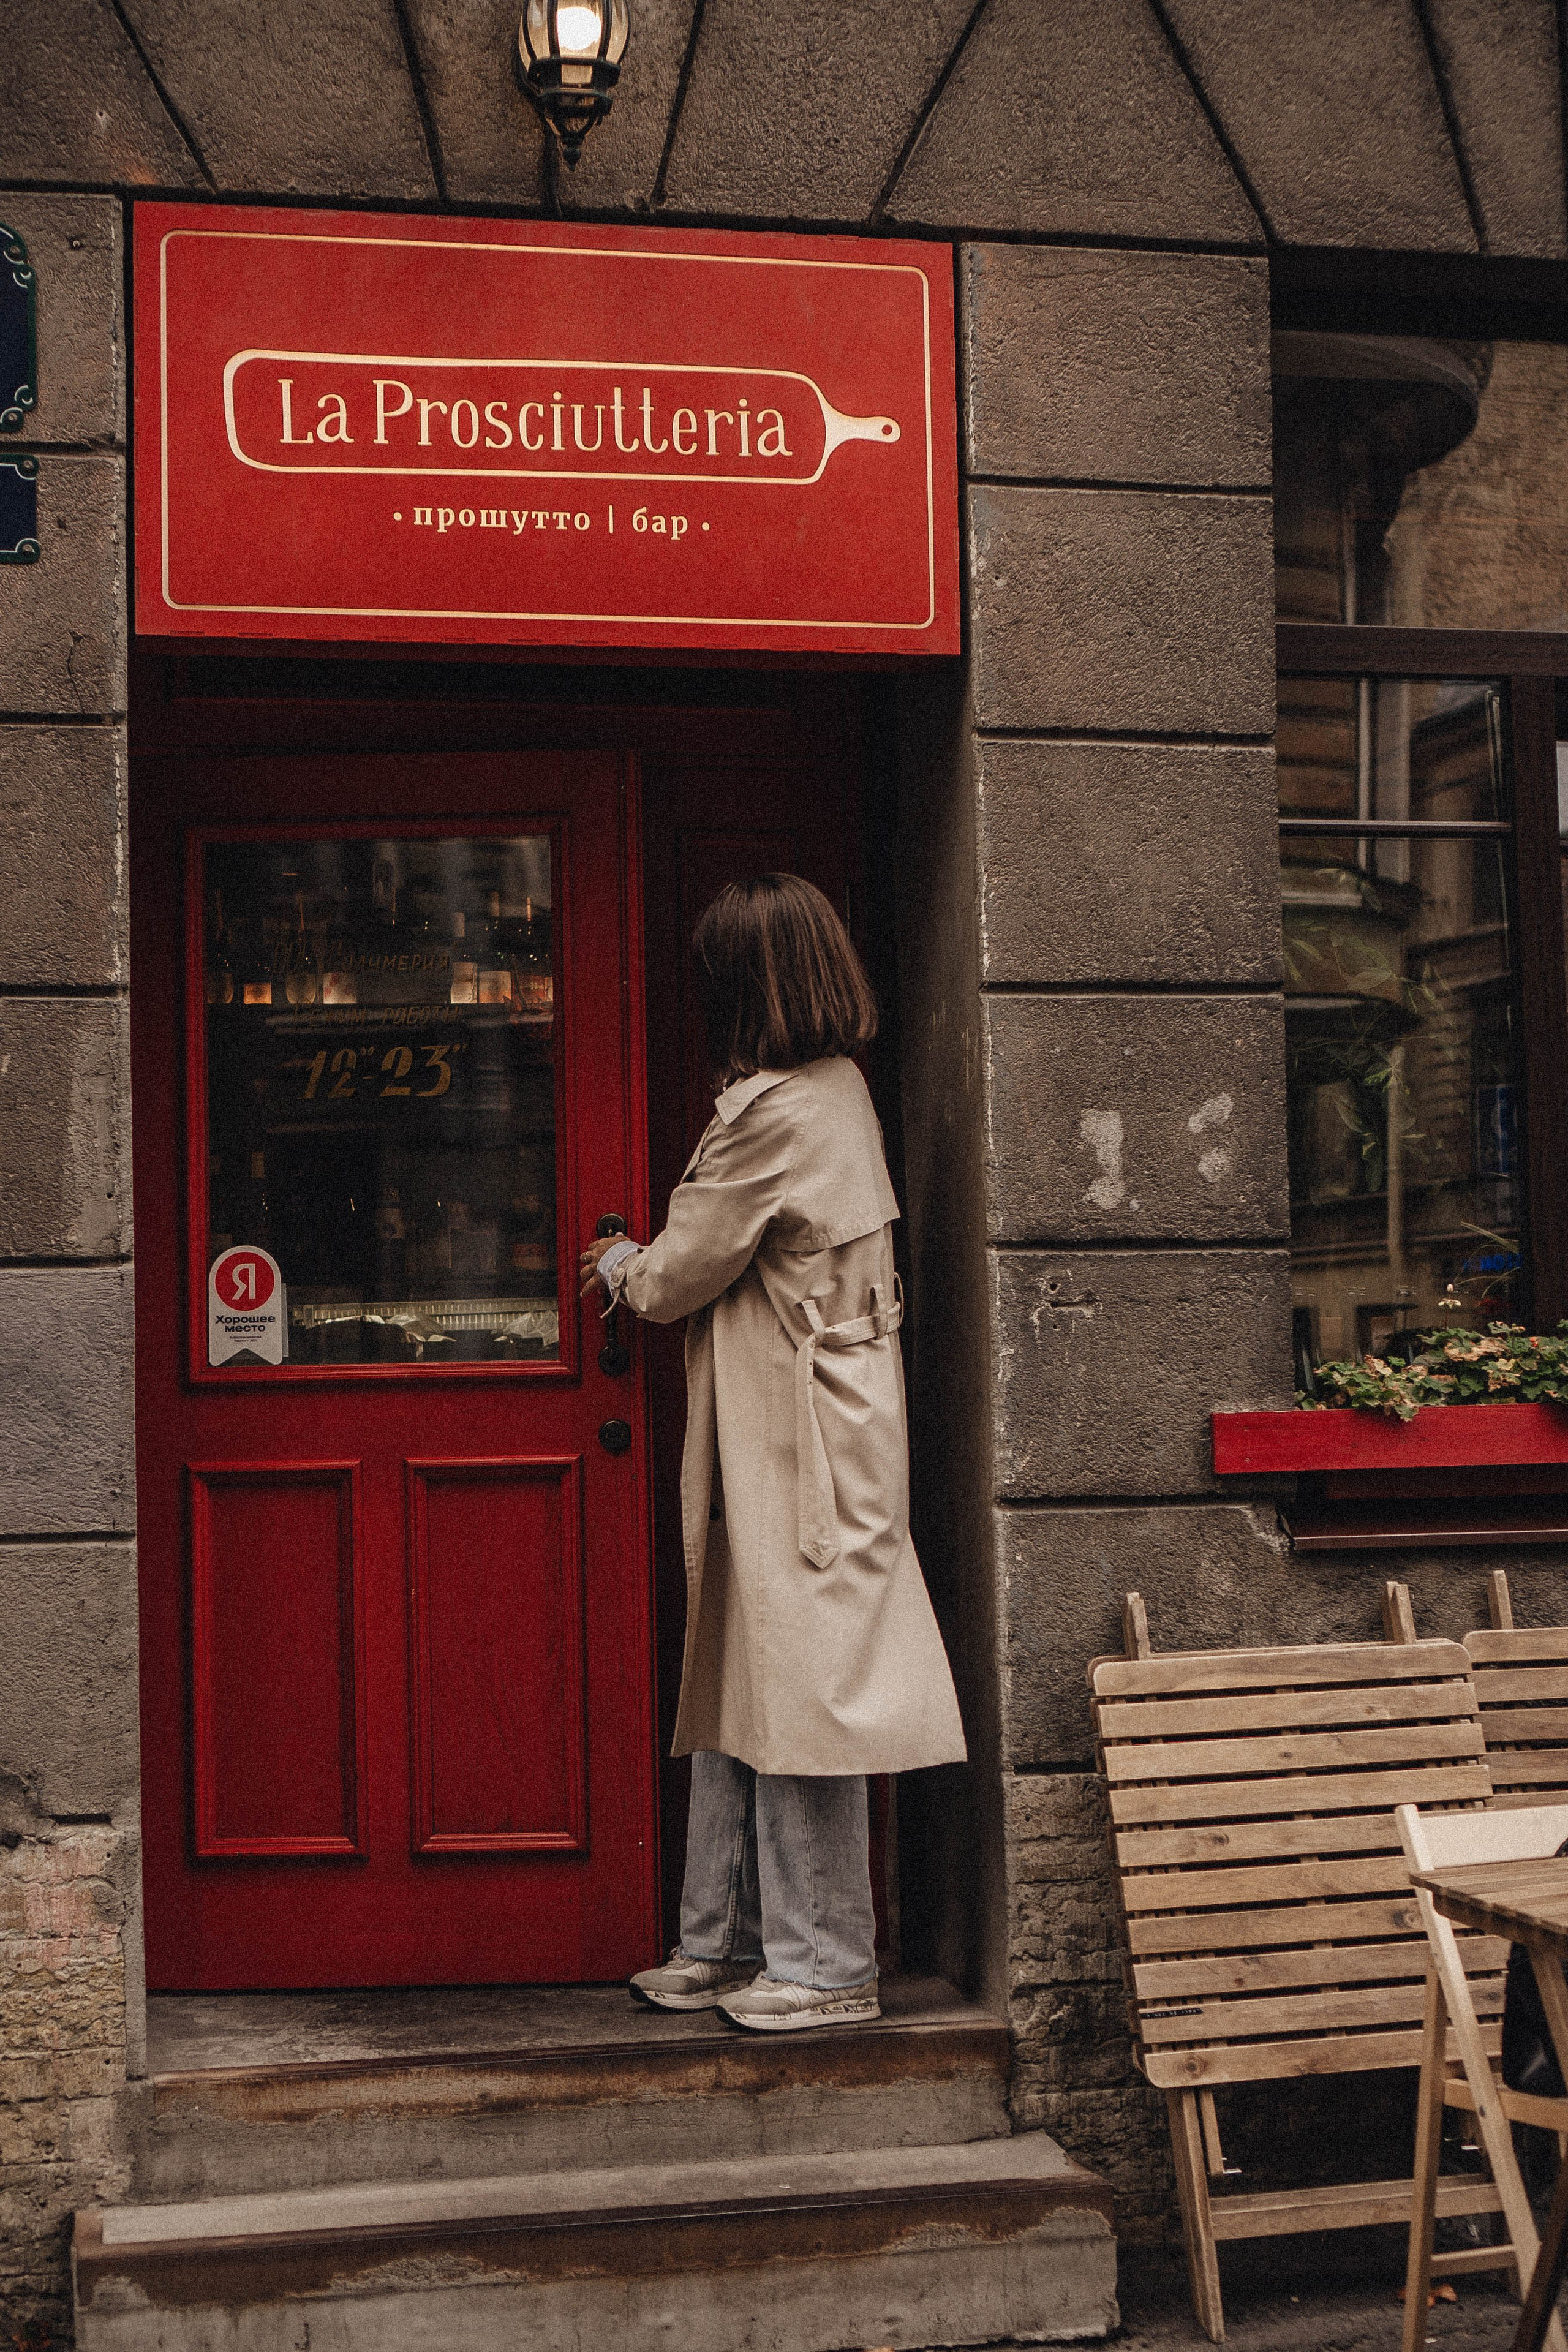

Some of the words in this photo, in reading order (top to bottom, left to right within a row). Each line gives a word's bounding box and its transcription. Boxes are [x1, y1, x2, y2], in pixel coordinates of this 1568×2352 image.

[277, 379, 355, 445] La
[372, 379, 794, 458] Prosciutteria
[413, 507, 591, 536] прошутто
[631, 505, 688, 541] бар
[232, 1263, 256, 1300] Я
[215, 1315, 276, 1325] Хорошее
